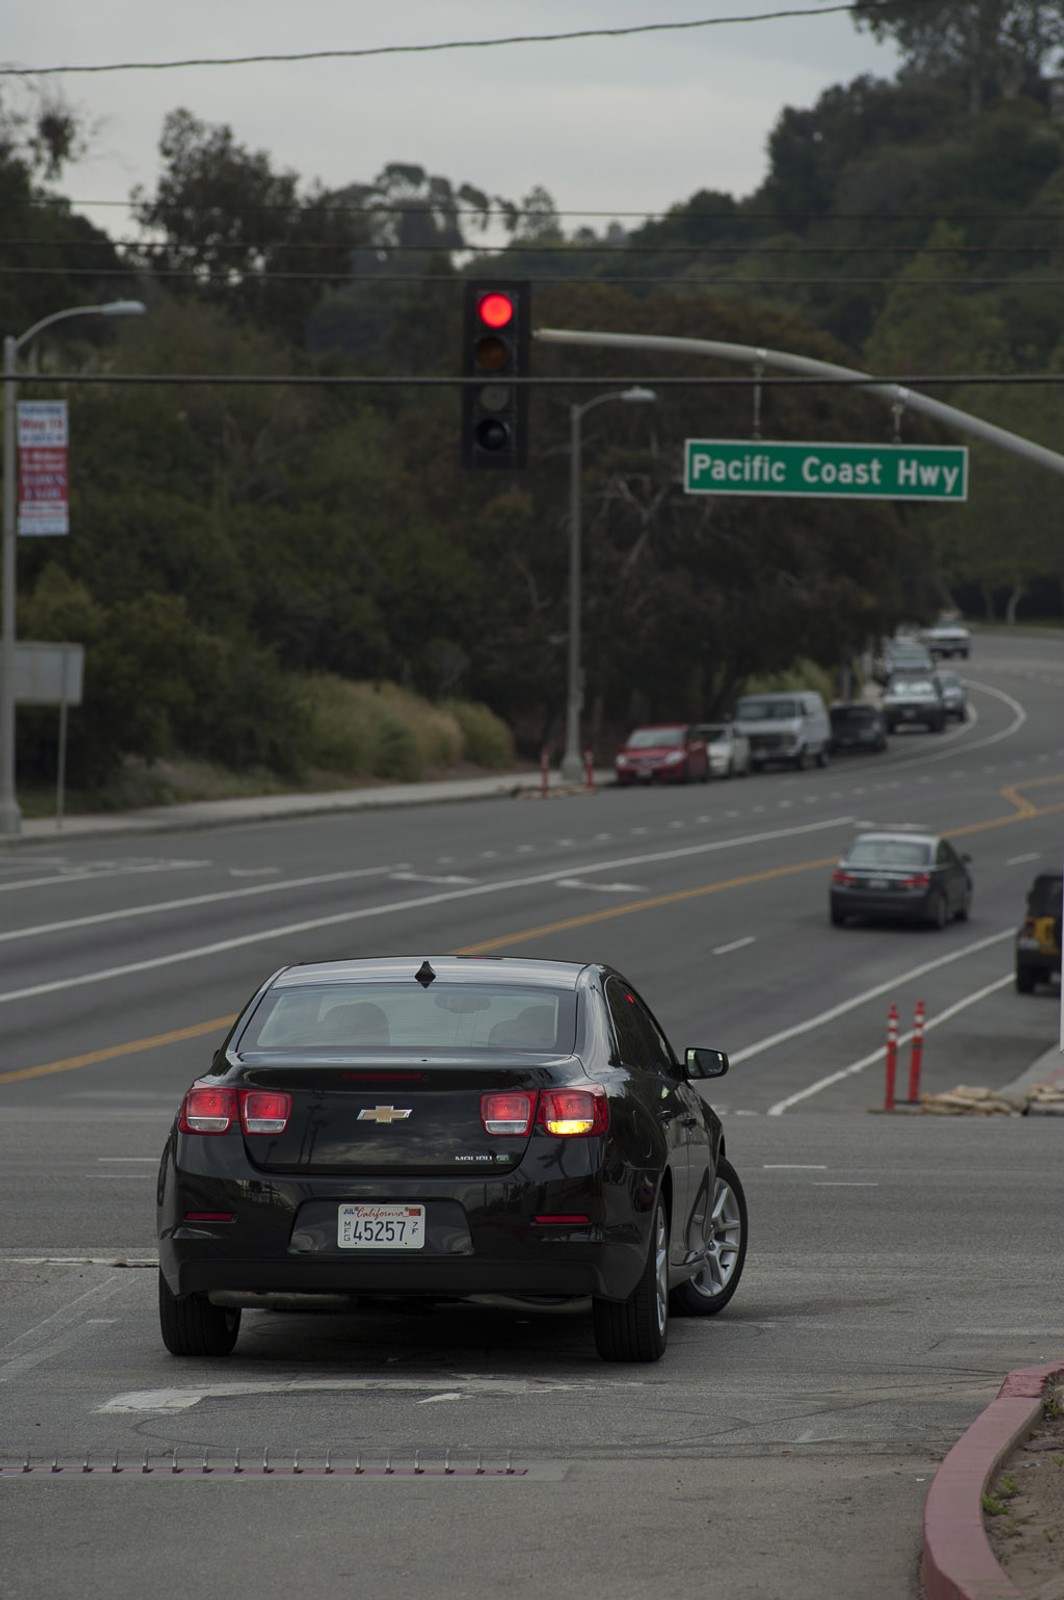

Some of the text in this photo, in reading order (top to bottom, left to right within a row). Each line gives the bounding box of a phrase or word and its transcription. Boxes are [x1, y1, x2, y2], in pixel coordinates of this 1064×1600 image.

[692, 453, 960, 494] Pacific Coast Hwy
[356, 1207, 404, 1221] California
[353, 1221, 406, 1242] 45257
